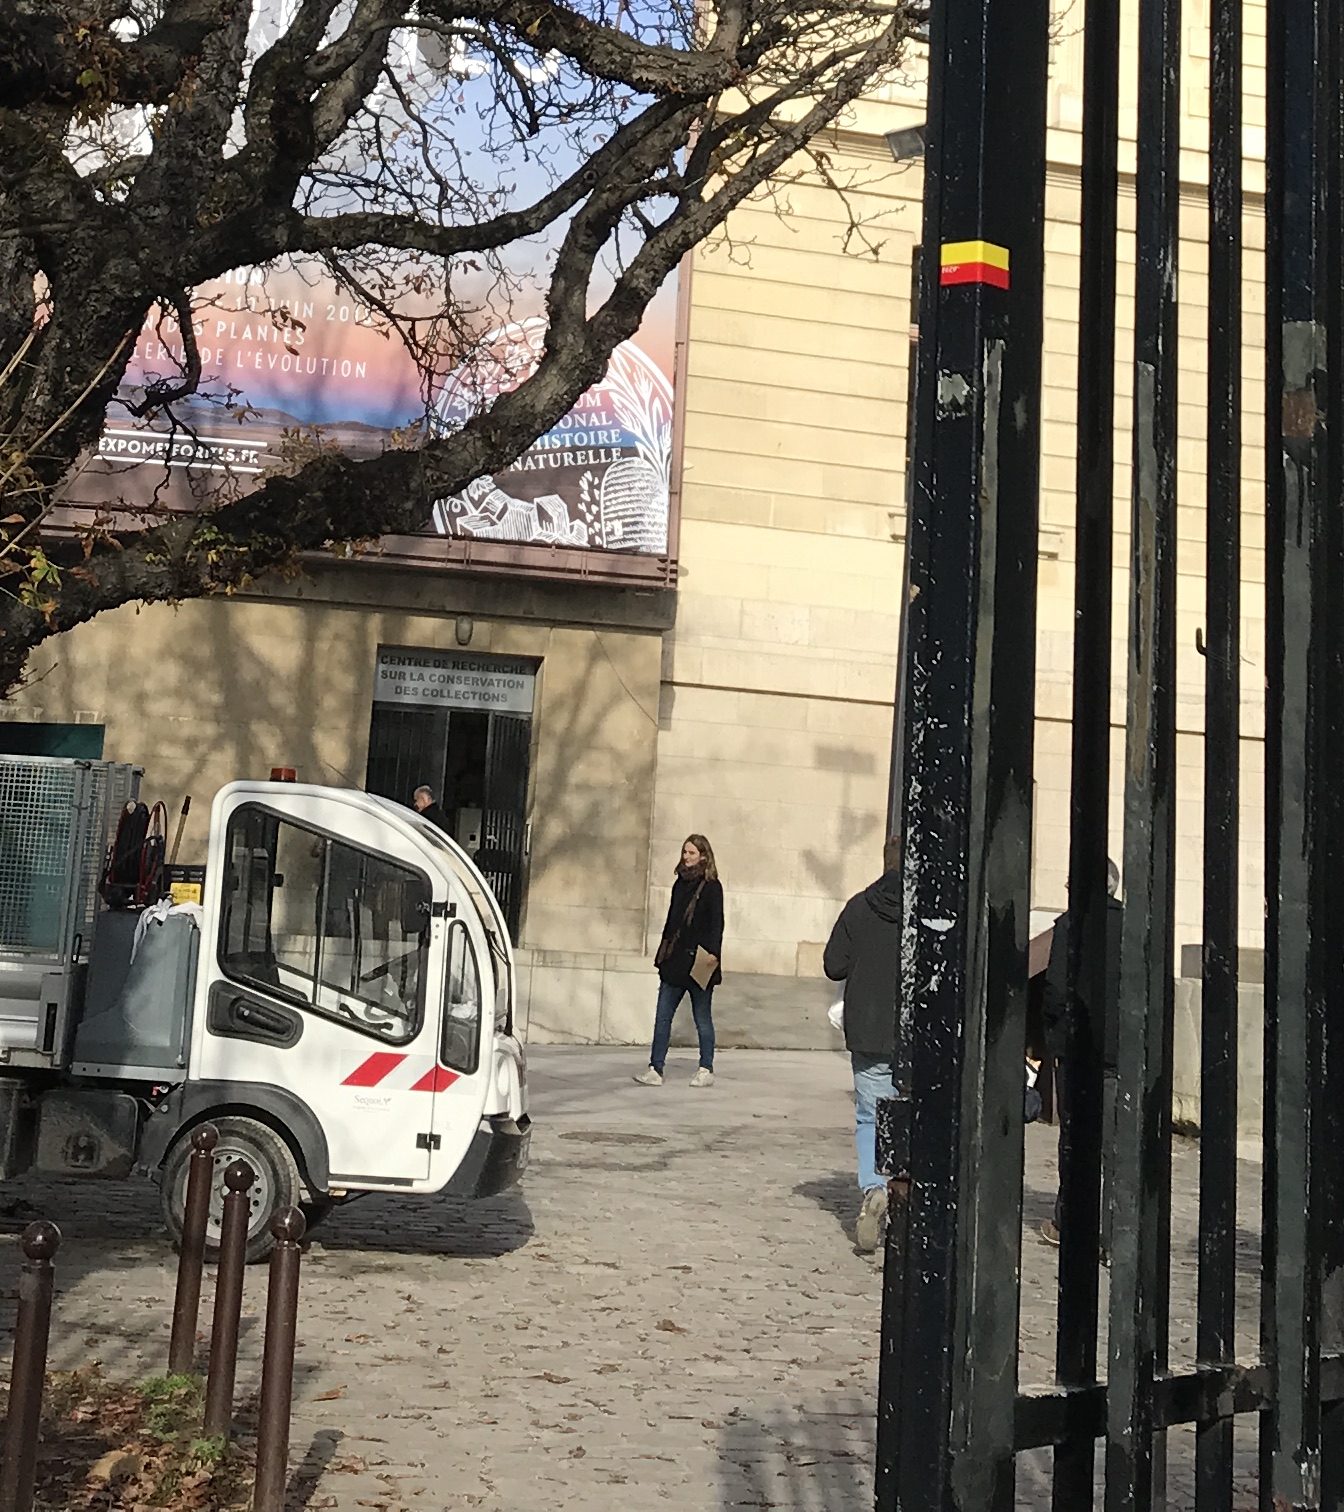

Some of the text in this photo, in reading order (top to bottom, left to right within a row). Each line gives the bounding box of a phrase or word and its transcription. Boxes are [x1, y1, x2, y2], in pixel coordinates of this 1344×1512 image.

[167, 317, 204, 336] DS
[215, 320, 306, 346] PLANTES
[201, 346, 225, 366] DE
[236, 347, 367, 378] L'ÉVOLUTION
[528, 428, 623, 452] HISTOIRE
[509, 447, 623, 473] NATURELLE
[380, 654, 527, 675] CENTRE DE RECHERCHE
[380, 669, 525, 690] SUR LA CONSERVATION
[394, 685, 508, 704] DES COLLECTIONS
